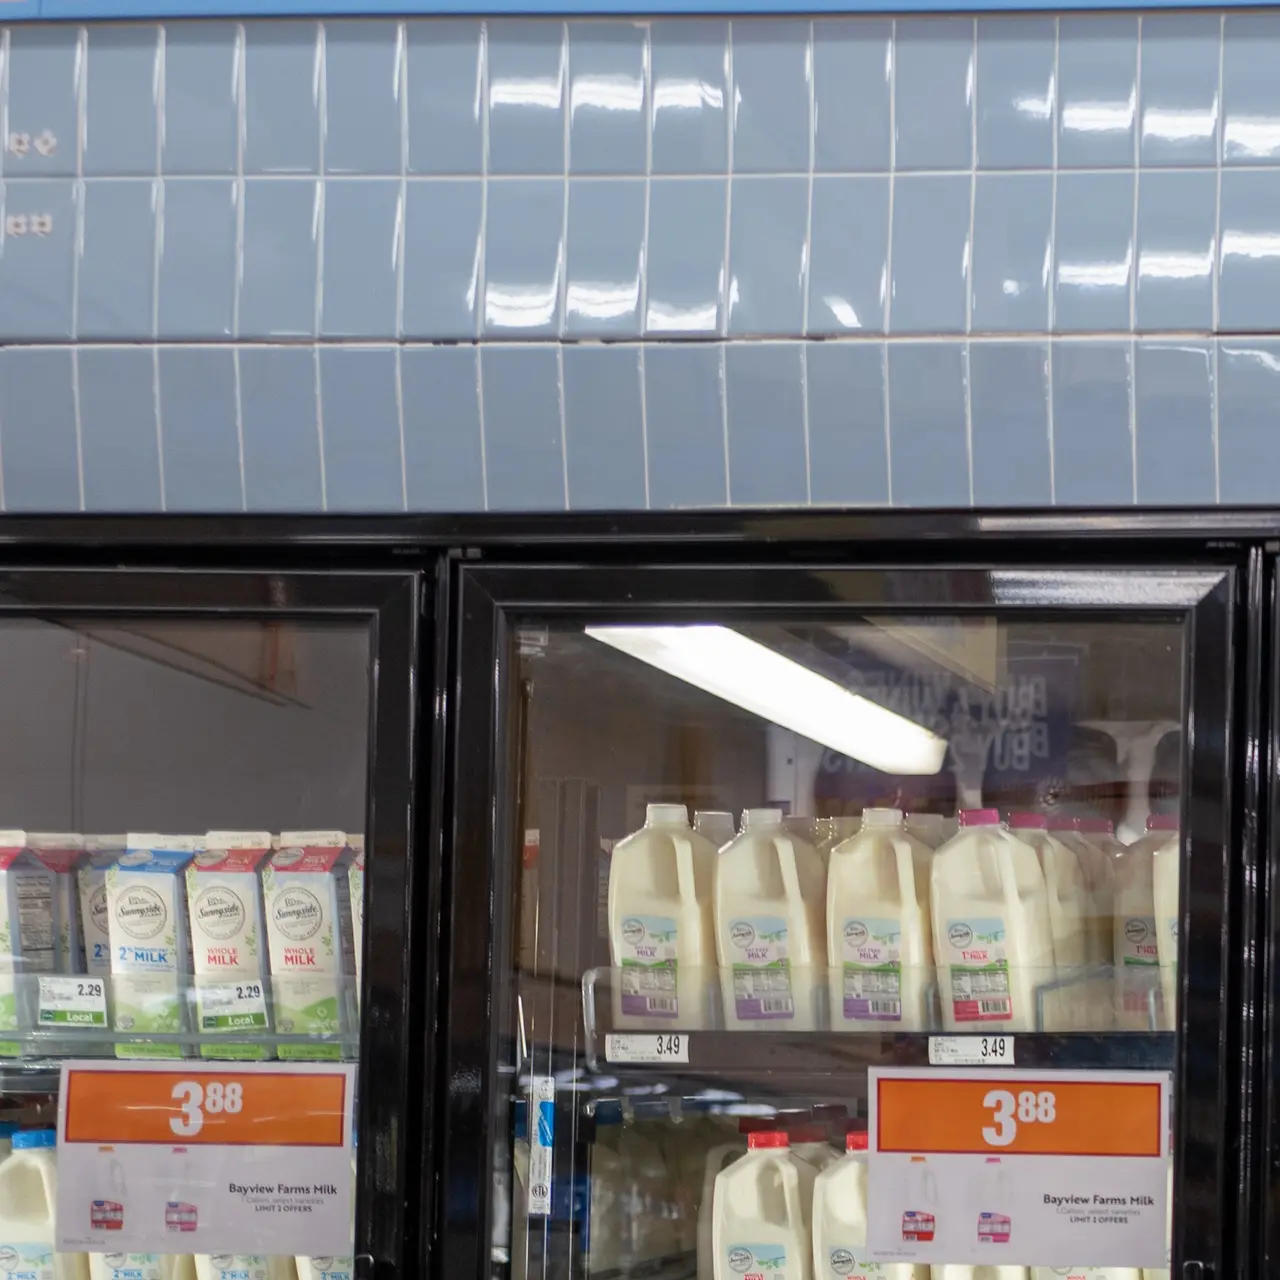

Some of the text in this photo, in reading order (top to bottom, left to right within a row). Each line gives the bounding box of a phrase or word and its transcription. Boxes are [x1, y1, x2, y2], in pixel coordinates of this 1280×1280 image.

[118, 906, 165, 920] Sunnyside
[135, 951, 168, 963] MILK
[208, 955, 238, 965] MILK
[77, 984, 101, 997] 2.29
[237, 986, 260, 999] 2.29
[66, 1012, 93, 1022] Local
[228, 1015, 254, 1025] Local
[656, 1037, 680, 1055] 3.49
[981, 1038, 1005, 1056] 3.49
[229, 1183, 337, 1195] Bayview Farms Milk
[1043, 1194, 1154, 1206] Bayview Farms Milk
